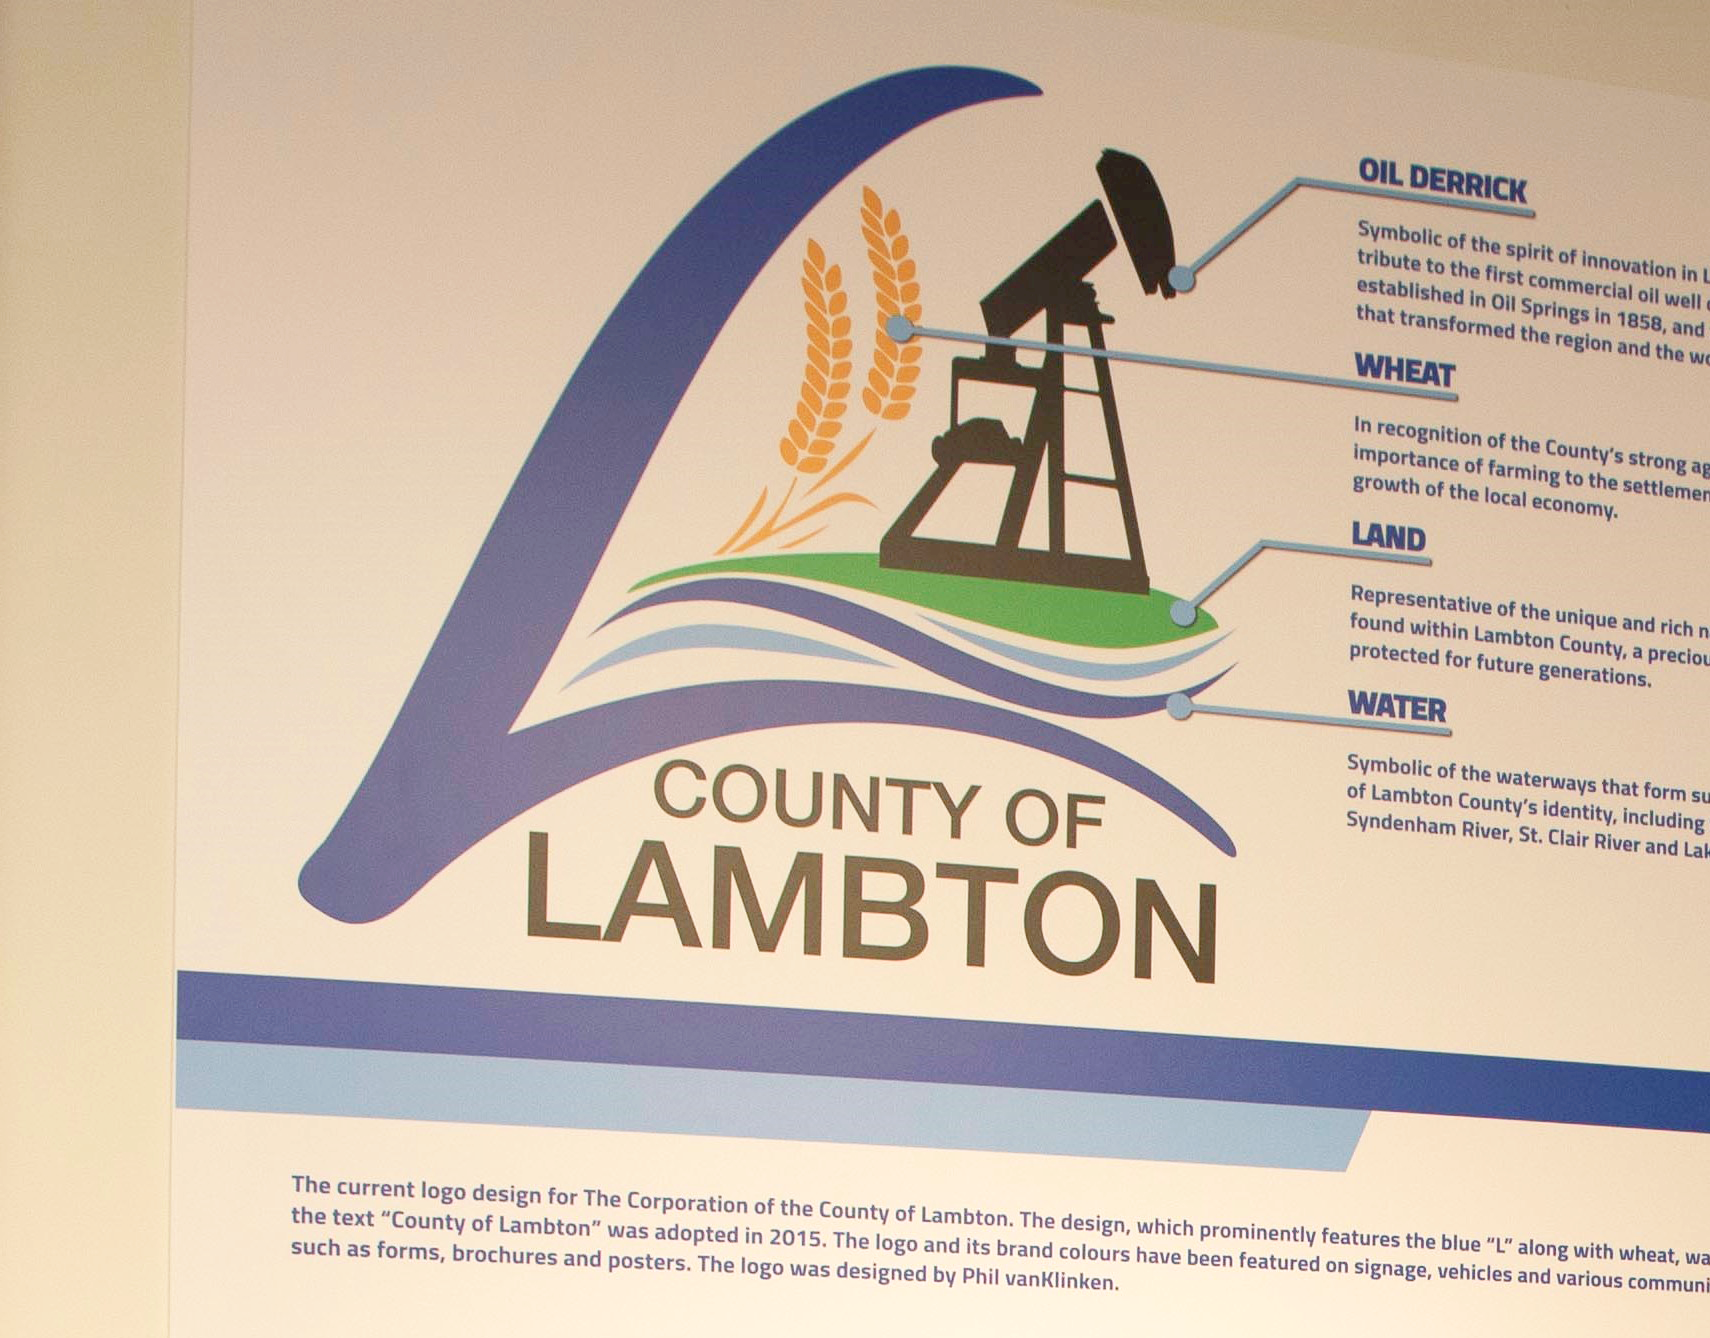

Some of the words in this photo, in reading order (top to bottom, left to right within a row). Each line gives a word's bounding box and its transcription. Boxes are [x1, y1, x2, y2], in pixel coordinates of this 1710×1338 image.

[1360, 157, 1404, 187] OIL
[1411, 164, 1527, 204] DERRICK
[1359, 219, 1443, 247] Symbolic
[1448, 233, 1467, 250] of
[1471, 235, 1501, 255] the
[1507, 242, 1554, 263] spirit
[1559, 248, 1577, 265] of
[1583, 250, 1677, 280] innovation
[1682, 264, 1698, 283] in
[1358, 248, 1422, 273] tribute
[1427, 257, 1446, 275] to
[1450, 260, 1481, 280] the
[1486, 264, 1524, 287] first
[1529, 275, 1633, 301] commercial
[1639, 287, 1659, 305] oil
[1665, 293, 1702, 311] well
[1357, 303, 1396, 325] that
[1400, 309, 1516, 340] transformed
[1521, 325, 1551, 345] the
[1556, 333, 1613, 354] region
[1618, 341, 1651, 358] and
[1656, 343, 1685, 363] the
[1358, 279, 1465, 306] established
[1471, 290, 1486, 309] in
[1492, 293, 1516, 313] Oil
[1522, 297, 1590, 326] Springs
[1595, 306, 1611, 325] in
[1618, 311, 1667, 335] 1858,
[1673, 321, 1705, 338] and
[1355, 351, 1457, 388] WHEAT
[1353, 521, 1426, 552] LAND
[1351, 611, 1405, 634] found
[1411, 619, 1469, 641] within
[1475, 625, 1555, 650] Lambton
[1560, 635, 1627, 662] County,
[1632, 646, 1643, 659] a
[1352, 584, 1492, 615] Representative
[1498, 600, 1517, 618] of
[1521, 603, 1551, 622] the
[1556, 608, 1618, 631] unique
[1623, 616, 1655, 633] and
[1661, 618, 1694, 638] rich
[1350, 644, 1440, 666] protected
[1446, 649, 1472, 669] for
[1477, 653, 1534, 676] future
[1539, 664, 1652, 689] generations.
[1348, 689, 1447, 723] WATER
[653, 759, 983, 839] COUNTY
[1005, 788, 1106, 848] OF
[527, 831, 1217, 984] LAMBTON
[292, 1175, 331, 1194] The
[338, 1181, 415, 1199] current
[422, 1182, 467, 1205] logo
[473, 1185, 542, 1209] design
[548, 1188, 579, 1206] for
[584, 1190, 621, 1208] The
[628, 1192, 748, 1215] Corporation
[755, 1200, 775, 1215] of
[781, 1200, 813, 1217] the
[820, 1202, 890, 1226] County
[896, 1207, 916, 1222] of
[922, 1208, 1014, 1227] Lambton.
[1020, 1213, 1055, 1230] The
[1062, 1215, 1131, 1237] design,
[1138, 1220, 1194, 1237] which
[1201, 1225, 1317, 1248] prominently
[1322, 1228, 1401, 1248] features
[1406, 1233, 1436, 1250] the
[1442, 1234, 1481, 1253] blue
[1487, 1237, 1513, 1254] “L”
[1519, 1239, 1569, 1262] along
[1574, 1242, 1614, 1260] with
[1620, 1245, 1680, 1267] wheat,
